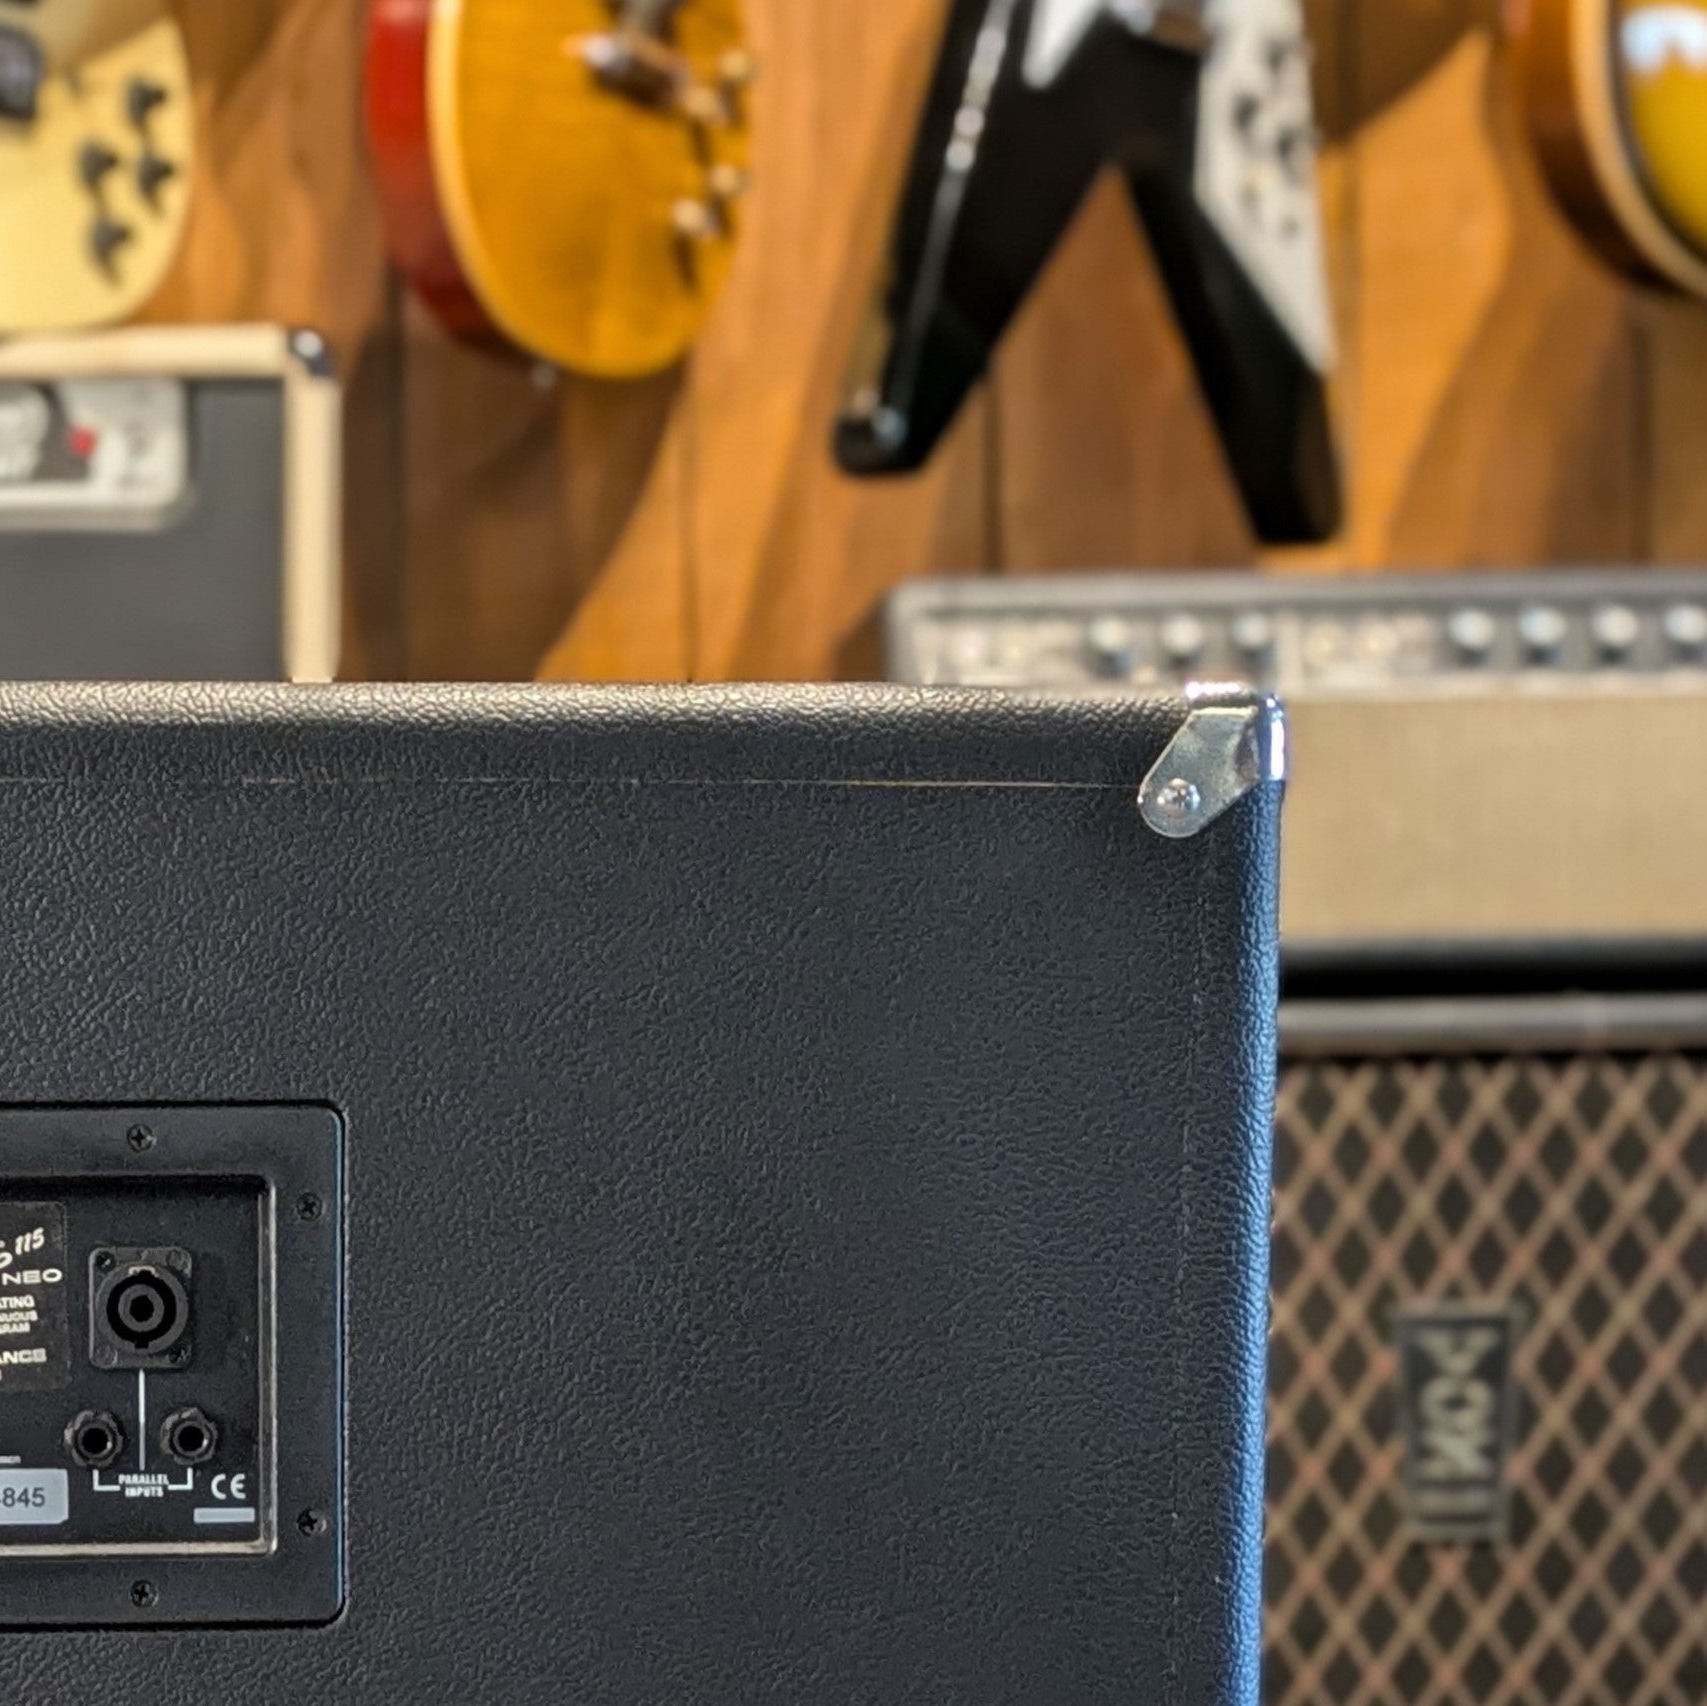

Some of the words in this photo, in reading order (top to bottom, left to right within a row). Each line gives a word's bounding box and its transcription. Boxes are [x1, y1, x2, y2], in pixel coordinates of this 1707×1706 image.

[14, 1227, 46, 1256] 115
[1, 1268, 63, 1286] NEO
[118, 1473, 169, 1486] PARALLEL
[124, 1485, 164, 1498] INPUTS
